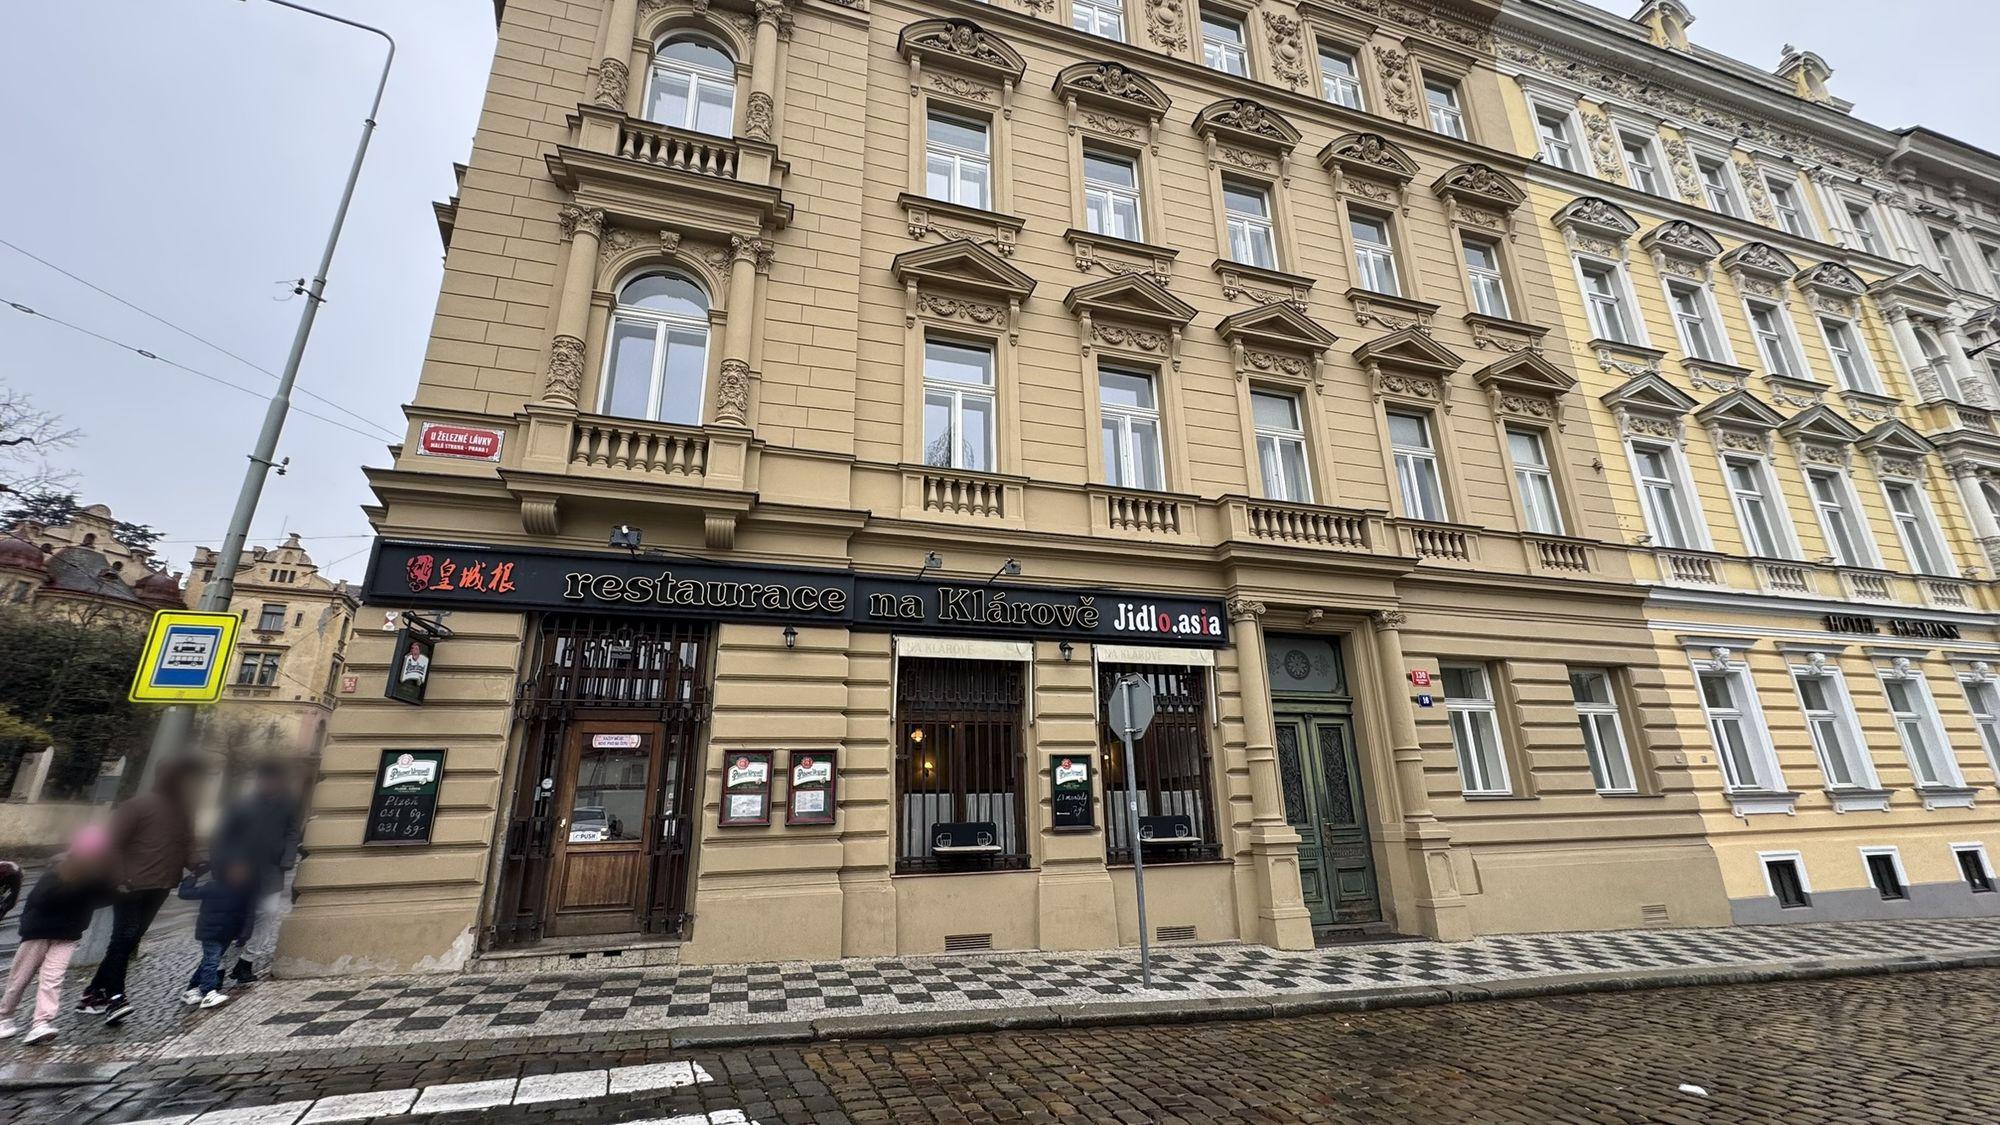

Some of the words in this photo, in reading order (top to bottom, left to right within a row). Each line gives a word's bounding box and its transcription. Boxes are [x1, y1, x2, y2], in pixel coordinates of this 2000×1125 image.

[430, 431, 436, 441] U
[437, 431, 467, 444] ŽELEZNÉ
[469, 434, 492, 446] LÁVKY
[445, 443, 464, 451] STRANA
[562, 571, 847, 613] restaurace
[868, 591, 925, 620] na
[937, 586, 1100, 629] Klárově
[1113, 602, 1222, 637] Jidlo.asia
